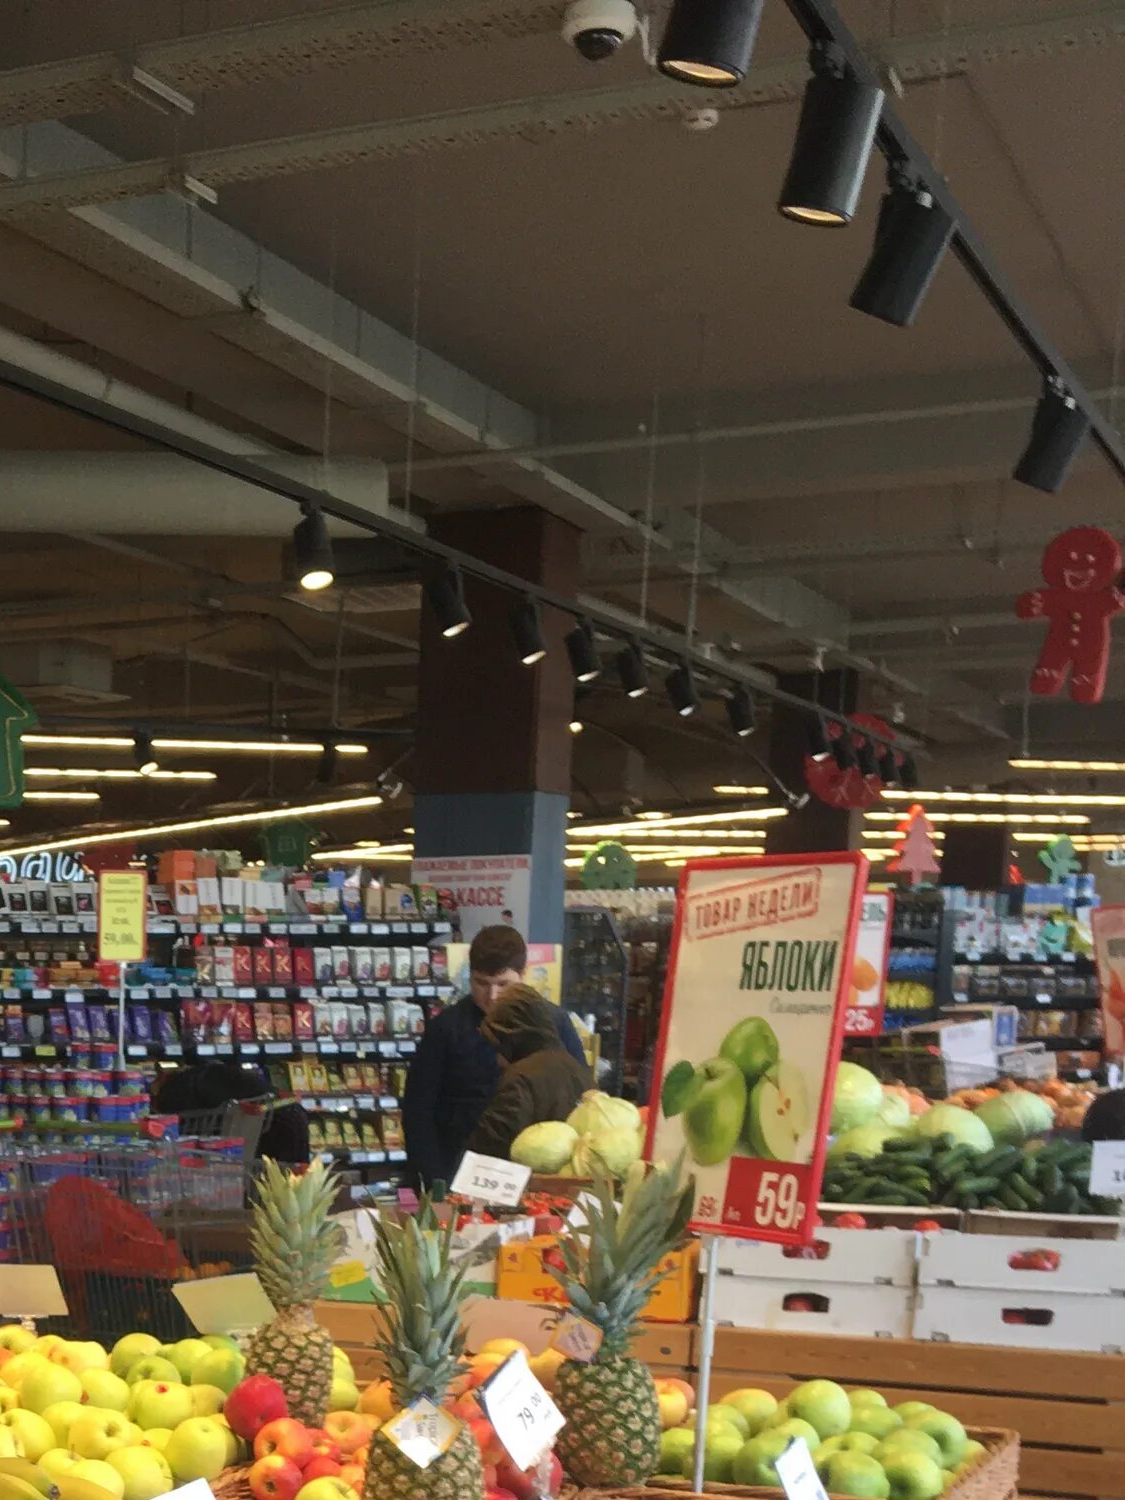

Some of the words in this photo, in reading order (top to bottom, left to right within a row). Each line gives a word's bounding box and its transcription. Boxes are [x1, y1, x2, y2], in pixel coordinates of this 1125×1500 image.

[456, 886, 506, 907] КАССЕ
[696, 897, 741, 930] ТОВАР
[739, 940, 839, 992] ЯБЛОКИ
[517, 1407, 535, 1431] 79
